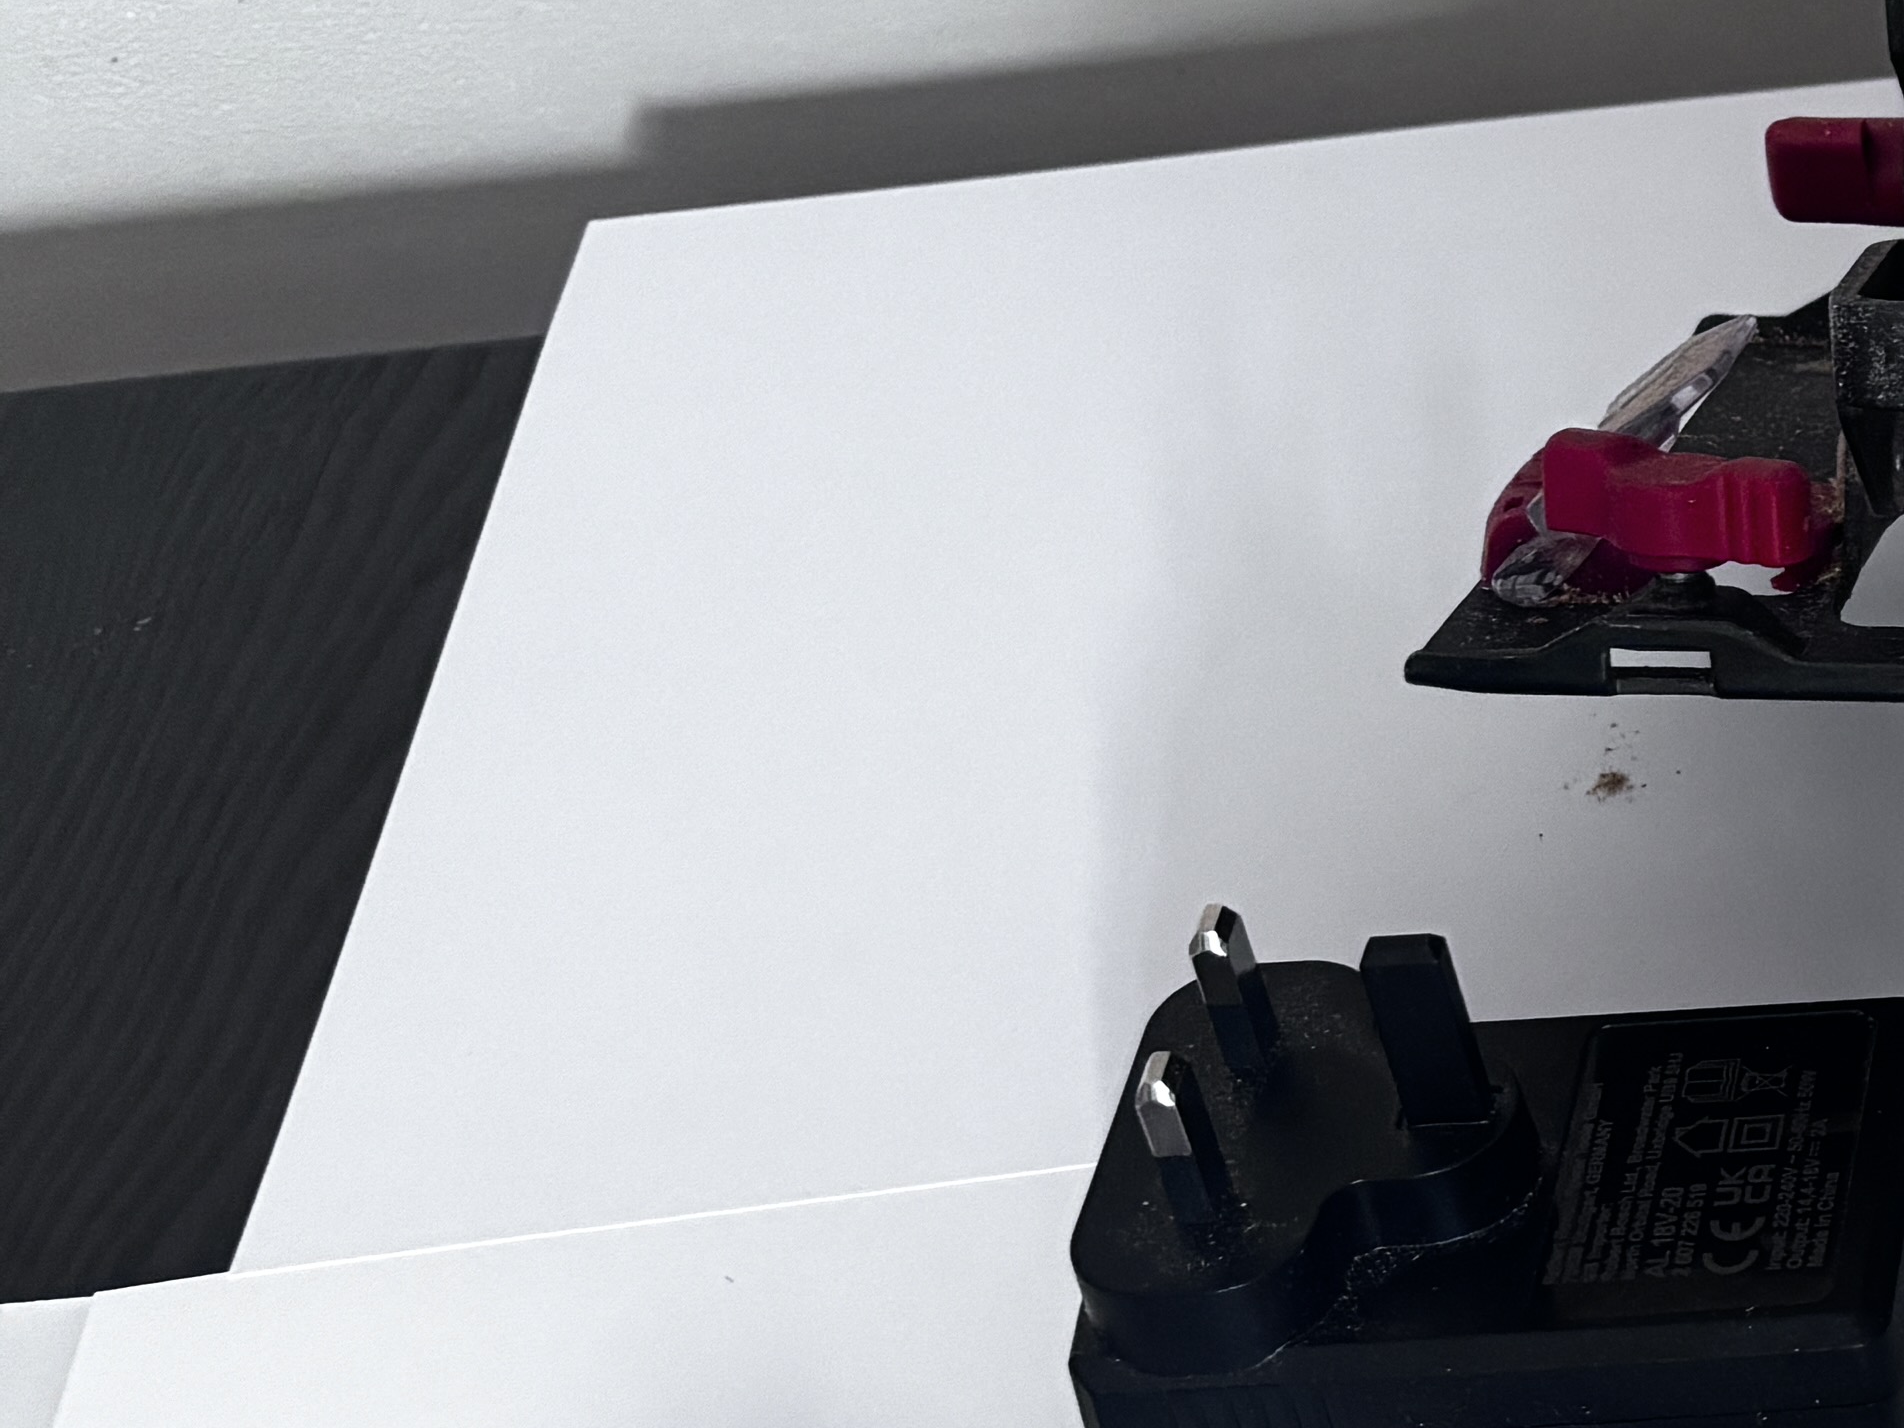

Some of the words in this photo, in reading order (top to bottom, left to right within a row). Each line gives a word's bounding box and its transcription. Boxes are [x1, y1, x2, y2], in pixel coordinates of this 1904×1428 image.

[1585, 1118, 1614, 1184] GERMANY
[1712, 1165, 1747, 1205] UK
[1816, 1171, 1840, 1210] China
[1648, 1186, 1685, 1246] 18V-20
